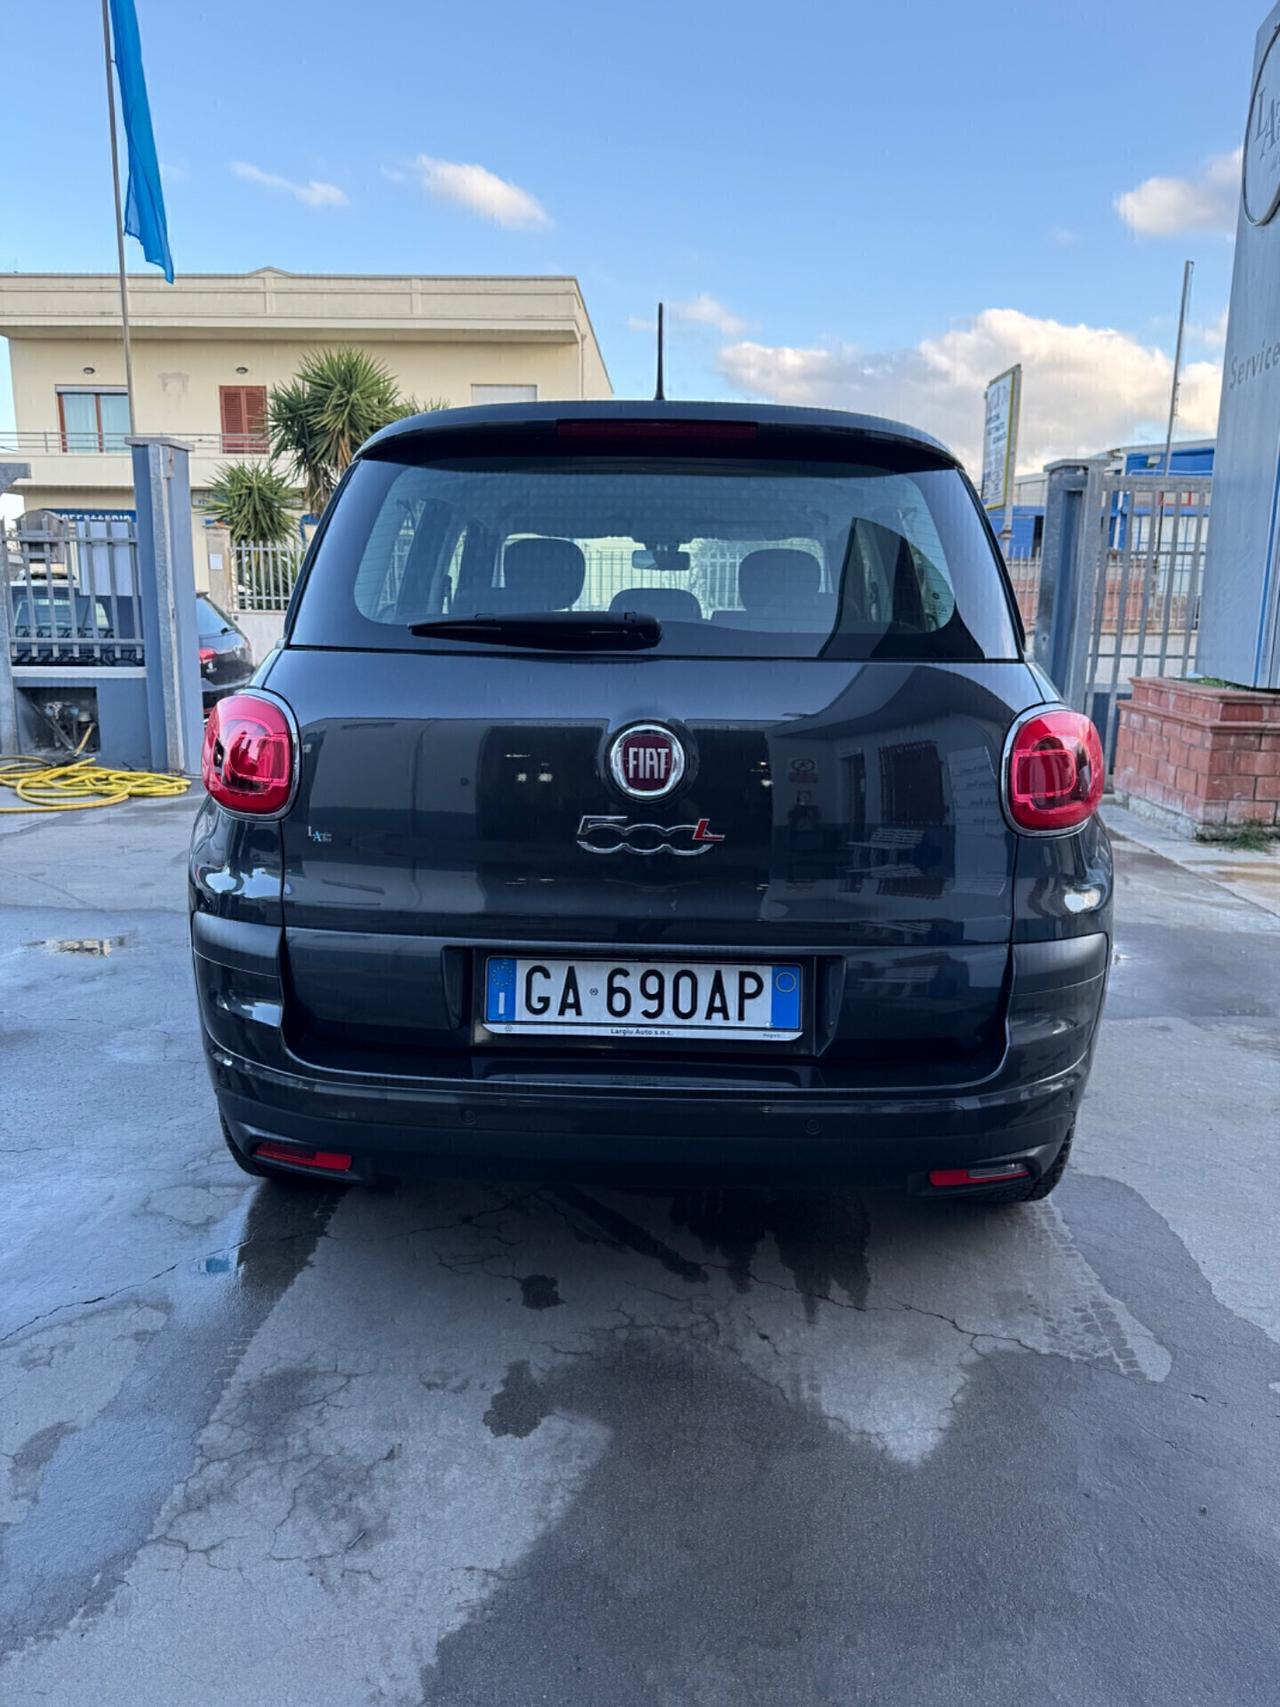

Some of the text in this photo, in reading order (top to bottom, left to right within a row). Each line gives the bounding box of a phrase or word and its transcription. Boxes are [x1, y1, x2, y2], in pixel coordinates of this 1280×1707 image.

[628, 747, 669, 779] FIAT
[577, 815, 725, 856] 500L
[524, 965, 764, 1022] GA 690AP
